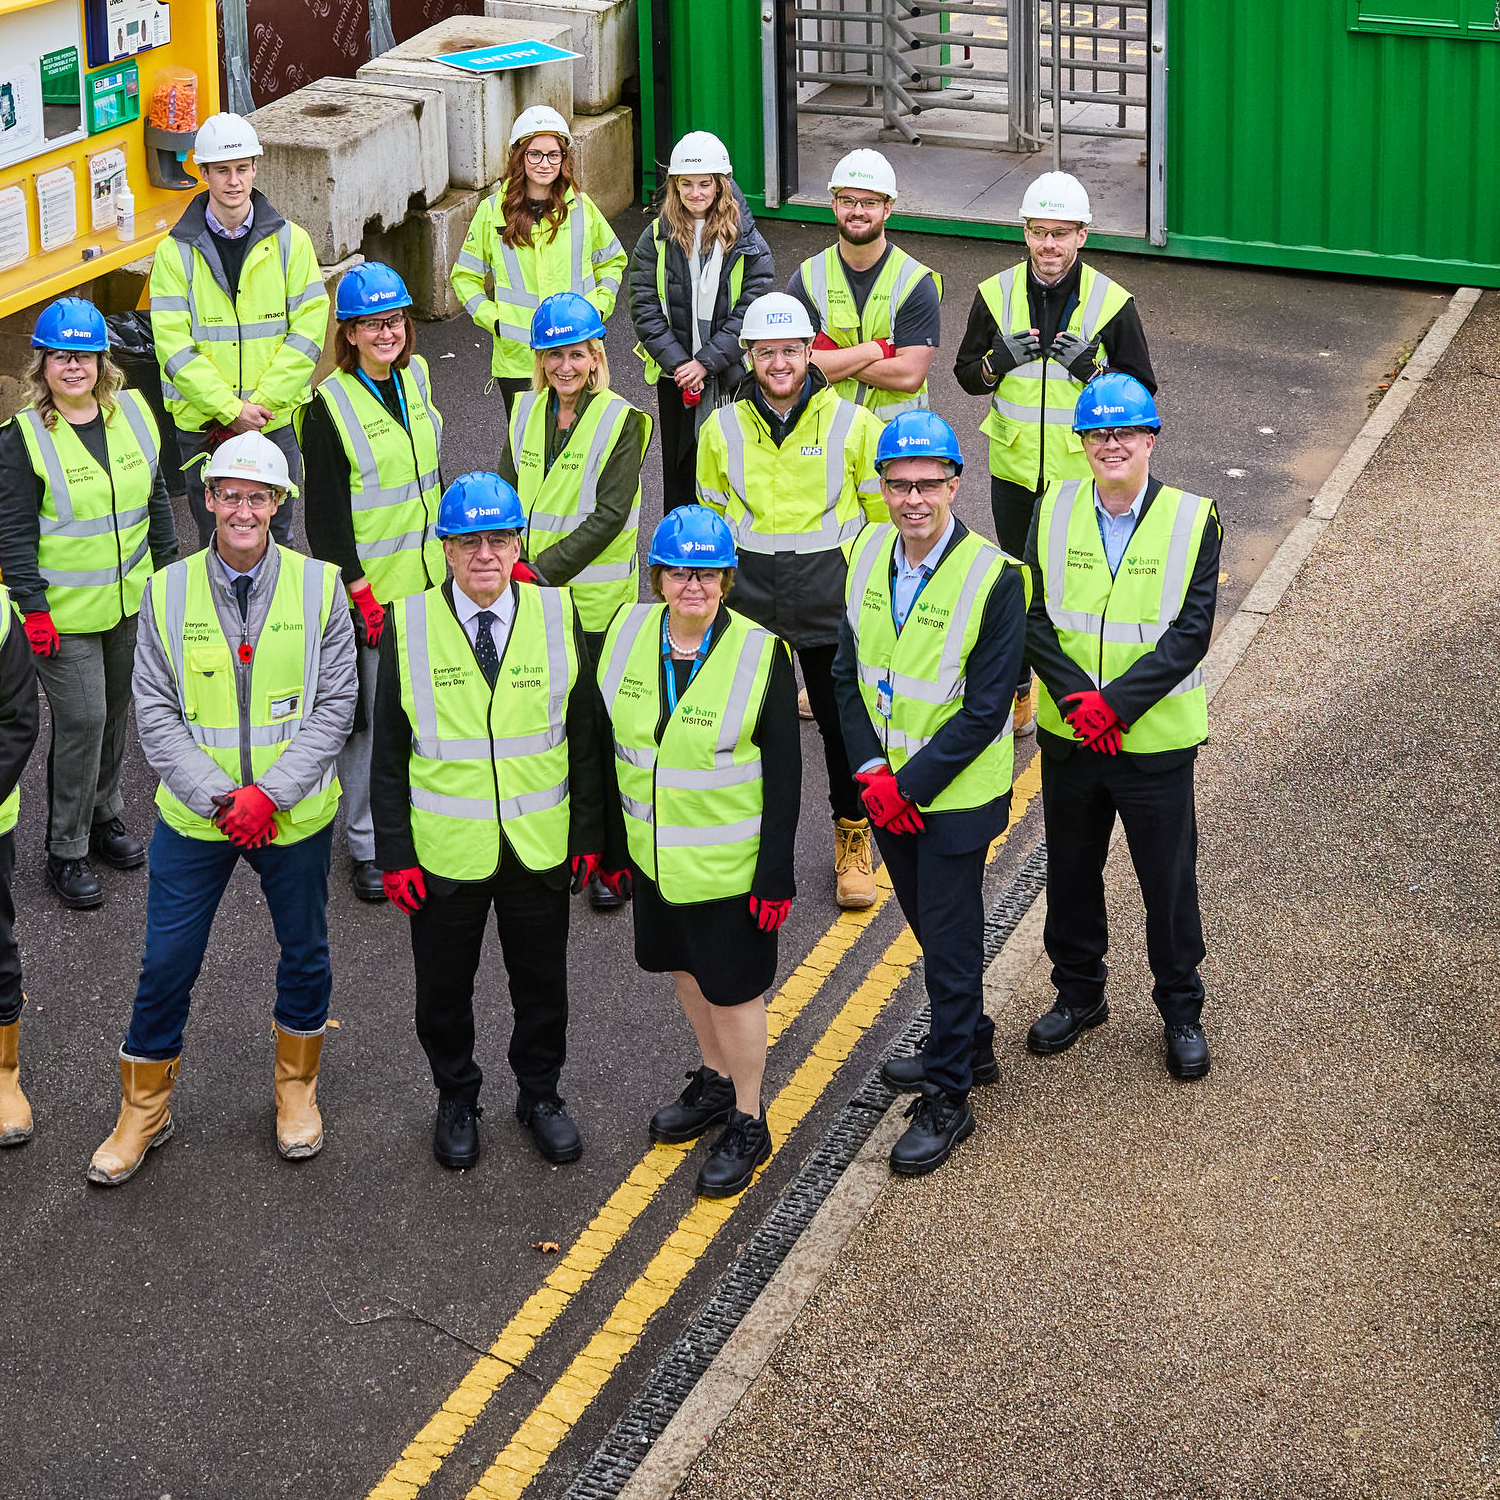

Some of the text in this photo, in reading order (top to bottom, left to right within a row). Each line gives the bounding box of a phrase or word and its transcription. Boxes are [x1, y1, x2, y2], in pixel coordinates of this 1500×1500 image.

[469, 49, 541, 65] ENTRY
[544, 118, 558, 126] bam
[92, 157, 107, 168] Don't
[857, 171, 873, 180] bam
[1048, 201, 1064, 209] bam
[381, 290, 397, 299] bam
[265, 311, 285, 320] mace
[768, 313, 791, 323] NHS
[73, 329, 91, 338] bam
[554, 325, 573, 334] bam
[1104, 405, 1124, 413] bam
[909, 437, 930, 446] bam
[125, 451, 139, 460] bam
[802, 447, 822, 455] NHS
[122, 459, 143, 472] VISITOR
[479, 507, 500, 516] bam
[694, 542, 715, 552] bam
[1068, 548, 1093, 557] Everyone
[1067, 561, 1082, 570] Every
[1139, 557, 1159, 565] bam
[1128, 567, 1157, 576] VISITOR
[930, 603, 950, 617] bam
[283, 622, 303, 631] bam
[917, 616, 944, 629] VISITOR
[433, 666, 461, 674] Everyone
[523, 665, 544, 673] bam
[435, 678, 465, 687] Every Day
[511, 680, 541, 688] VISITOR
[623, 676, 643, 686] Everyone
[618, 688, 641, 700] Every Day
[695, 706, 717, 719] bam
[681, 716, 713, 728] VISITOR
